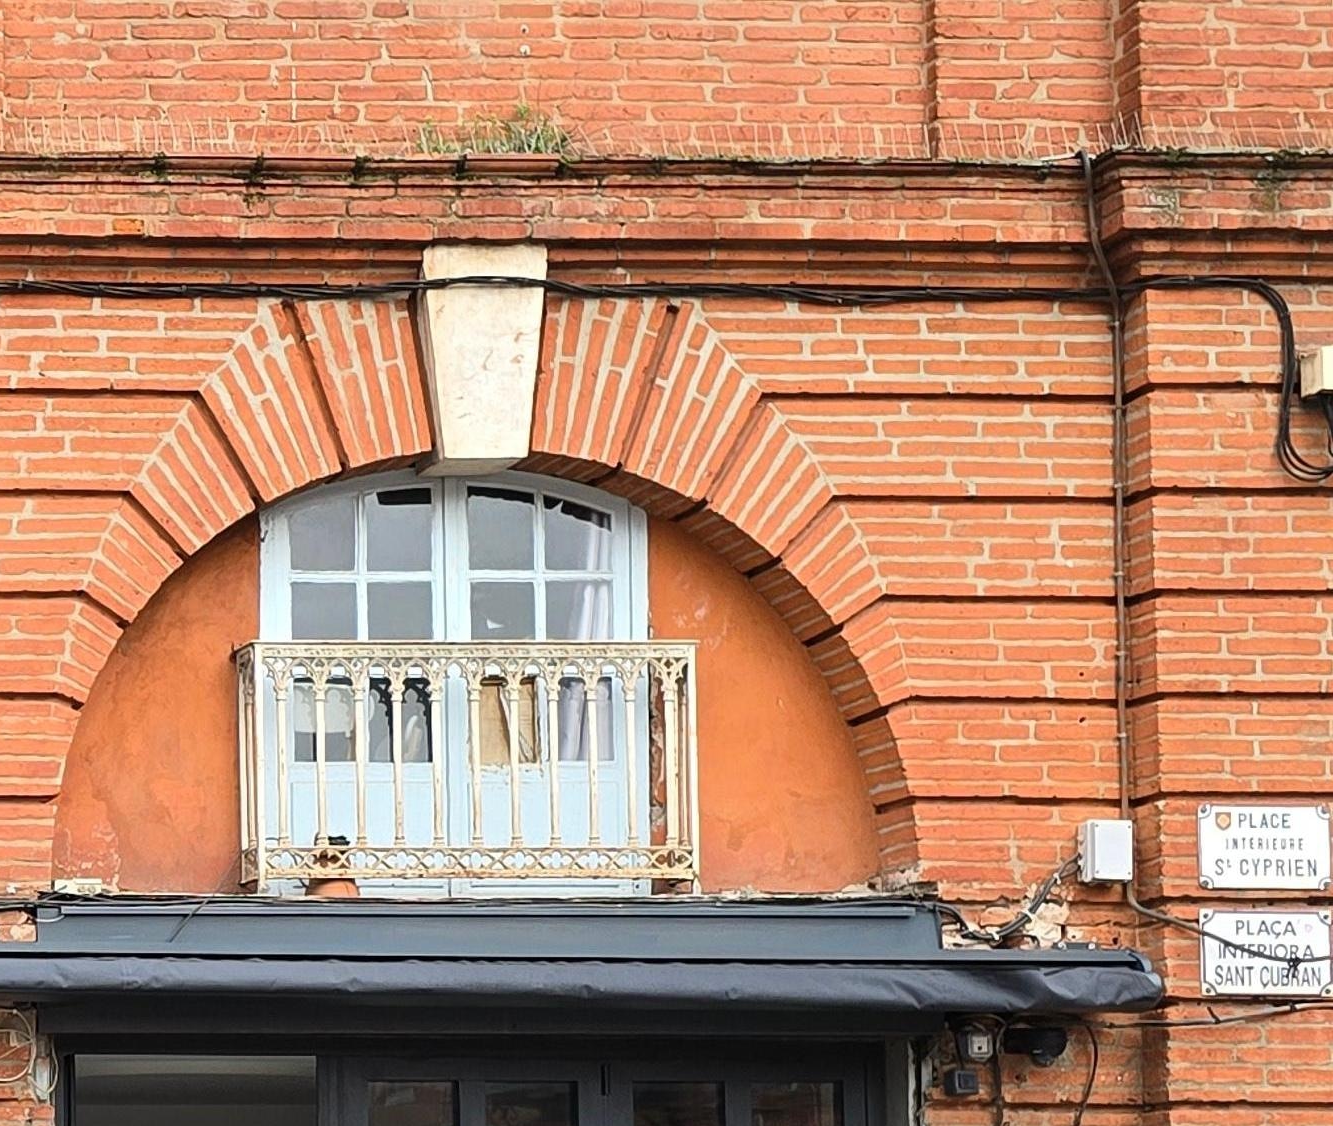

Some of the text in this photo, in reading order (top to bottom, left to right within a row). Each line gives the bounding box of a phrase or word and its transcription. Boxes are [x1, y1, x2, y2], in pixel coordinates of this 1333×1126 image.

[1238, 813, 1291, 829] PLACE
[1239, 858, 1318, 877] CYPRIEN
[1235, 919, 1297, 939] PLAÇA
[1218, 943, 1315, 960] INTERIORA
[1214, 966, 1254, 987] SANT
